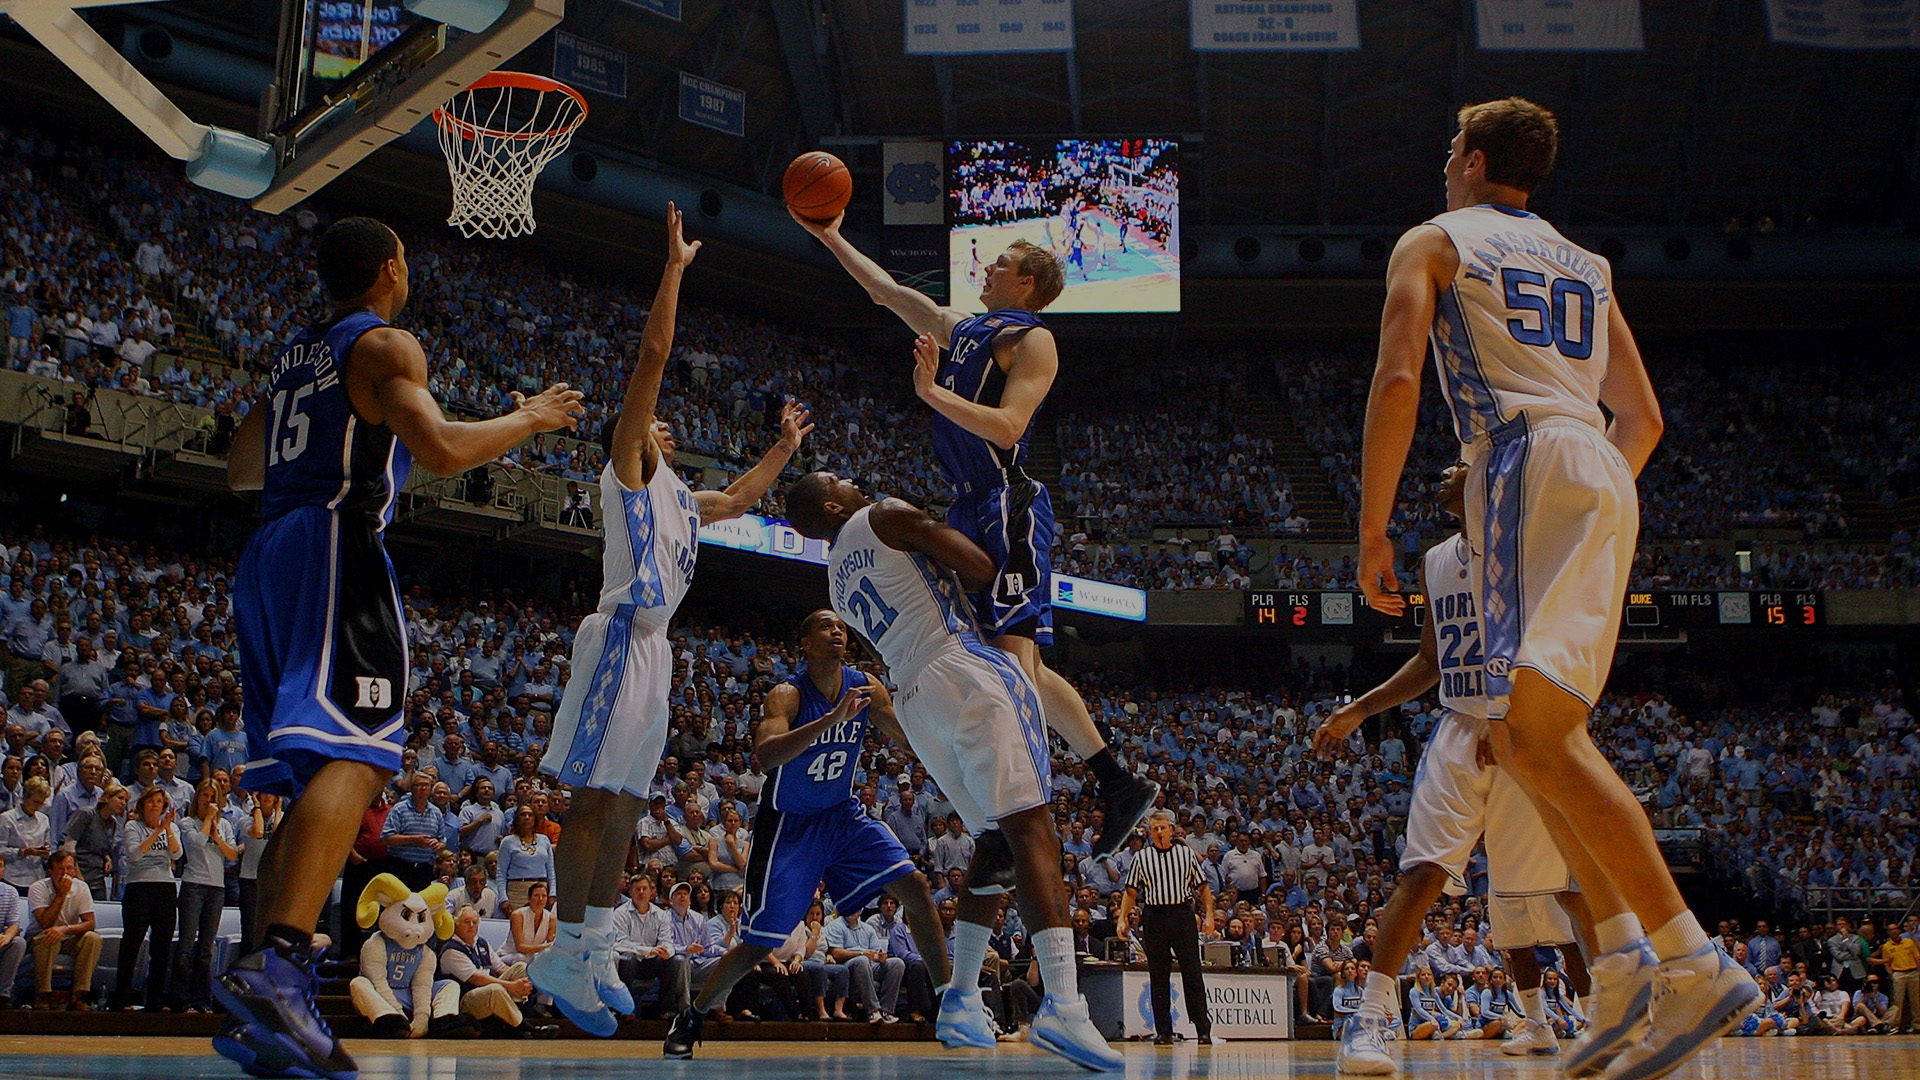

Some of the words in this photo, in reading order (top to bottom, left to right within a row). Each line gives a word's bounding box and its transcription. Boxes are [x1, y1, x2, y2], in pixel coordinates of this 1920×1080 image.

[1215, 4, 1266, 14] NATIONAL
[1268, 3, 1333, 14] CHAMPIONS
[1257, 16, 1275, 30] 32
[1213, 32, 1250, 42] COACH
[1252, 32, 1287, 42] FRANK
[682, 75, 699, 89] ACC
[700, 94, 726, 113] 1987
[1465, 231, 1610, 306] HANSBROUGH
[1500, 267, 1595, 361] 50
[269, 381, 315, 468] 15
[834, 548, 875, 614] THOMPSON
[1079, 589, 1137, 610] WACHOVIA
[1251, 594, 1274, 606] PLR
[1288, 594, 1309, 606] FLS
[1630, 593, 1653, 605] DUKE
[1671, 594, 1688, 606] TM
[1691, 593, 1712, 606] FLS
[1760, 593, 1783, 606] PLR
[1796, 593, 1817, 606] FLS
[847, 575, 899, 646] 21
[1257, 607, 1278, 624] 14
[1292, 606, 1308, 626] 2
[1767, 606, 1787, 625] 15
[1802, 605, 1816, 625] 3
[1440, 621, 1484, 670] 22
[810, 720, 862, 747] UKE
[807, 750, 848, 782] 42
[389, 952, 416, 964] NORTH
[392, 964, 406, 981] 5
[1205, 987, 1272, 1004] AROLINA
[1205, 1008, 1277, 1025] SKETBALL
